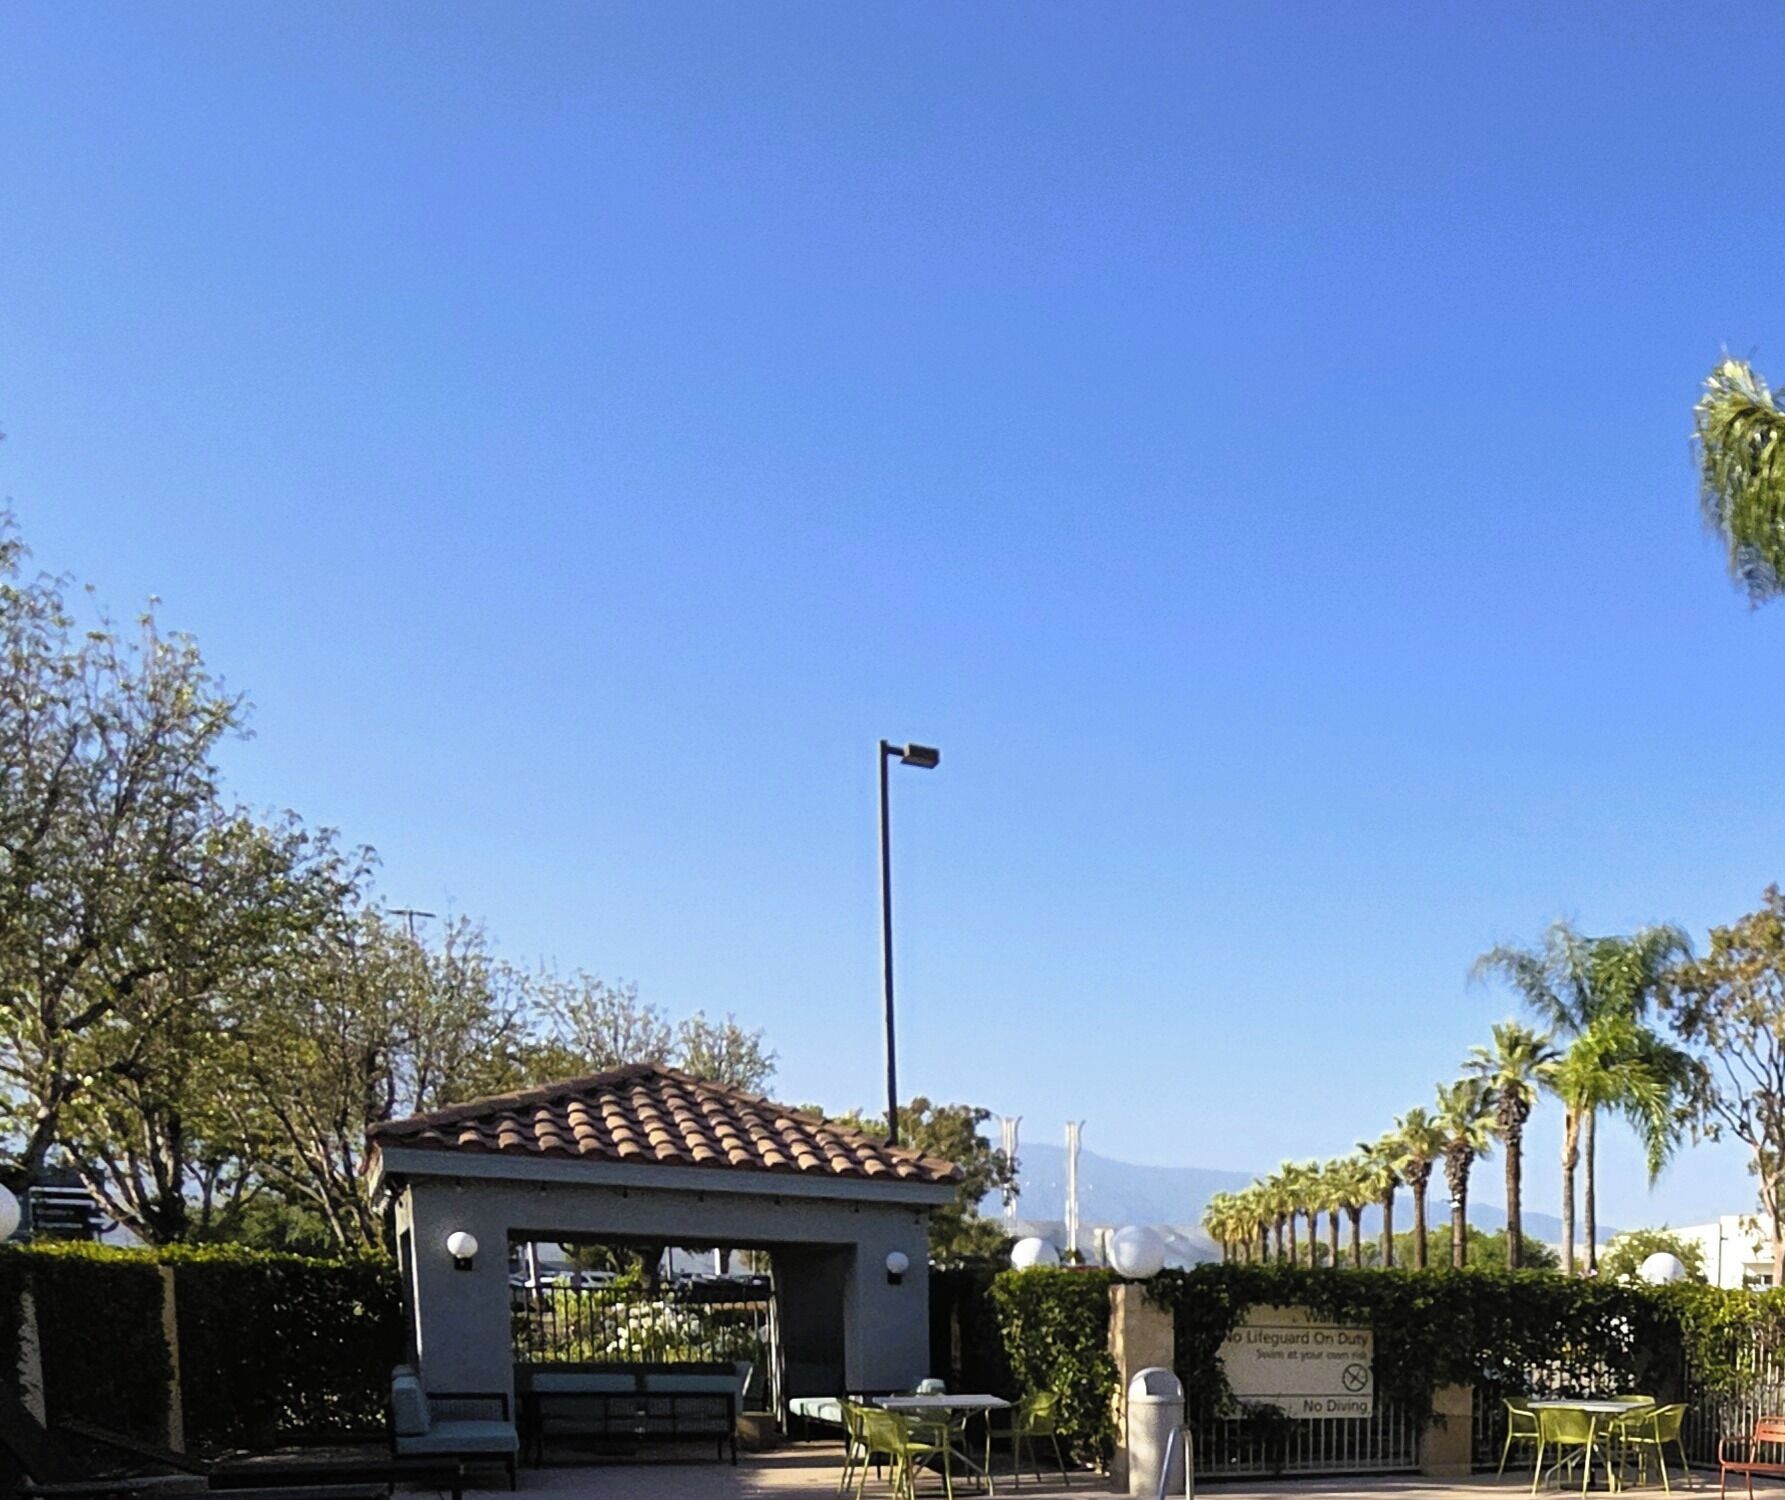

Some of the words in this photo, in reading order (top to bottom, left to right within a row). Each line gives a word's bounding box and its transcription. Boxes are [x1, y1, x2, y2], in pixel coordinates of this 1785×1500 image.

[1247, 1330, 1309, 1347] Lifeguard
[1314, 1332, 1334, 1344] On
[1338, 1332, 1369, 1348] Duty
[1256, 1348, 1284, 1360] Swim
[1287, 1350, 1298, 1360] at
[1300, 1351, 1323, 1362] your
[1327, 1351, 1349, 1360] own
[1303, 1399, 1322, 1413] No
[1327, 1399, 1368, 1415] Diving
